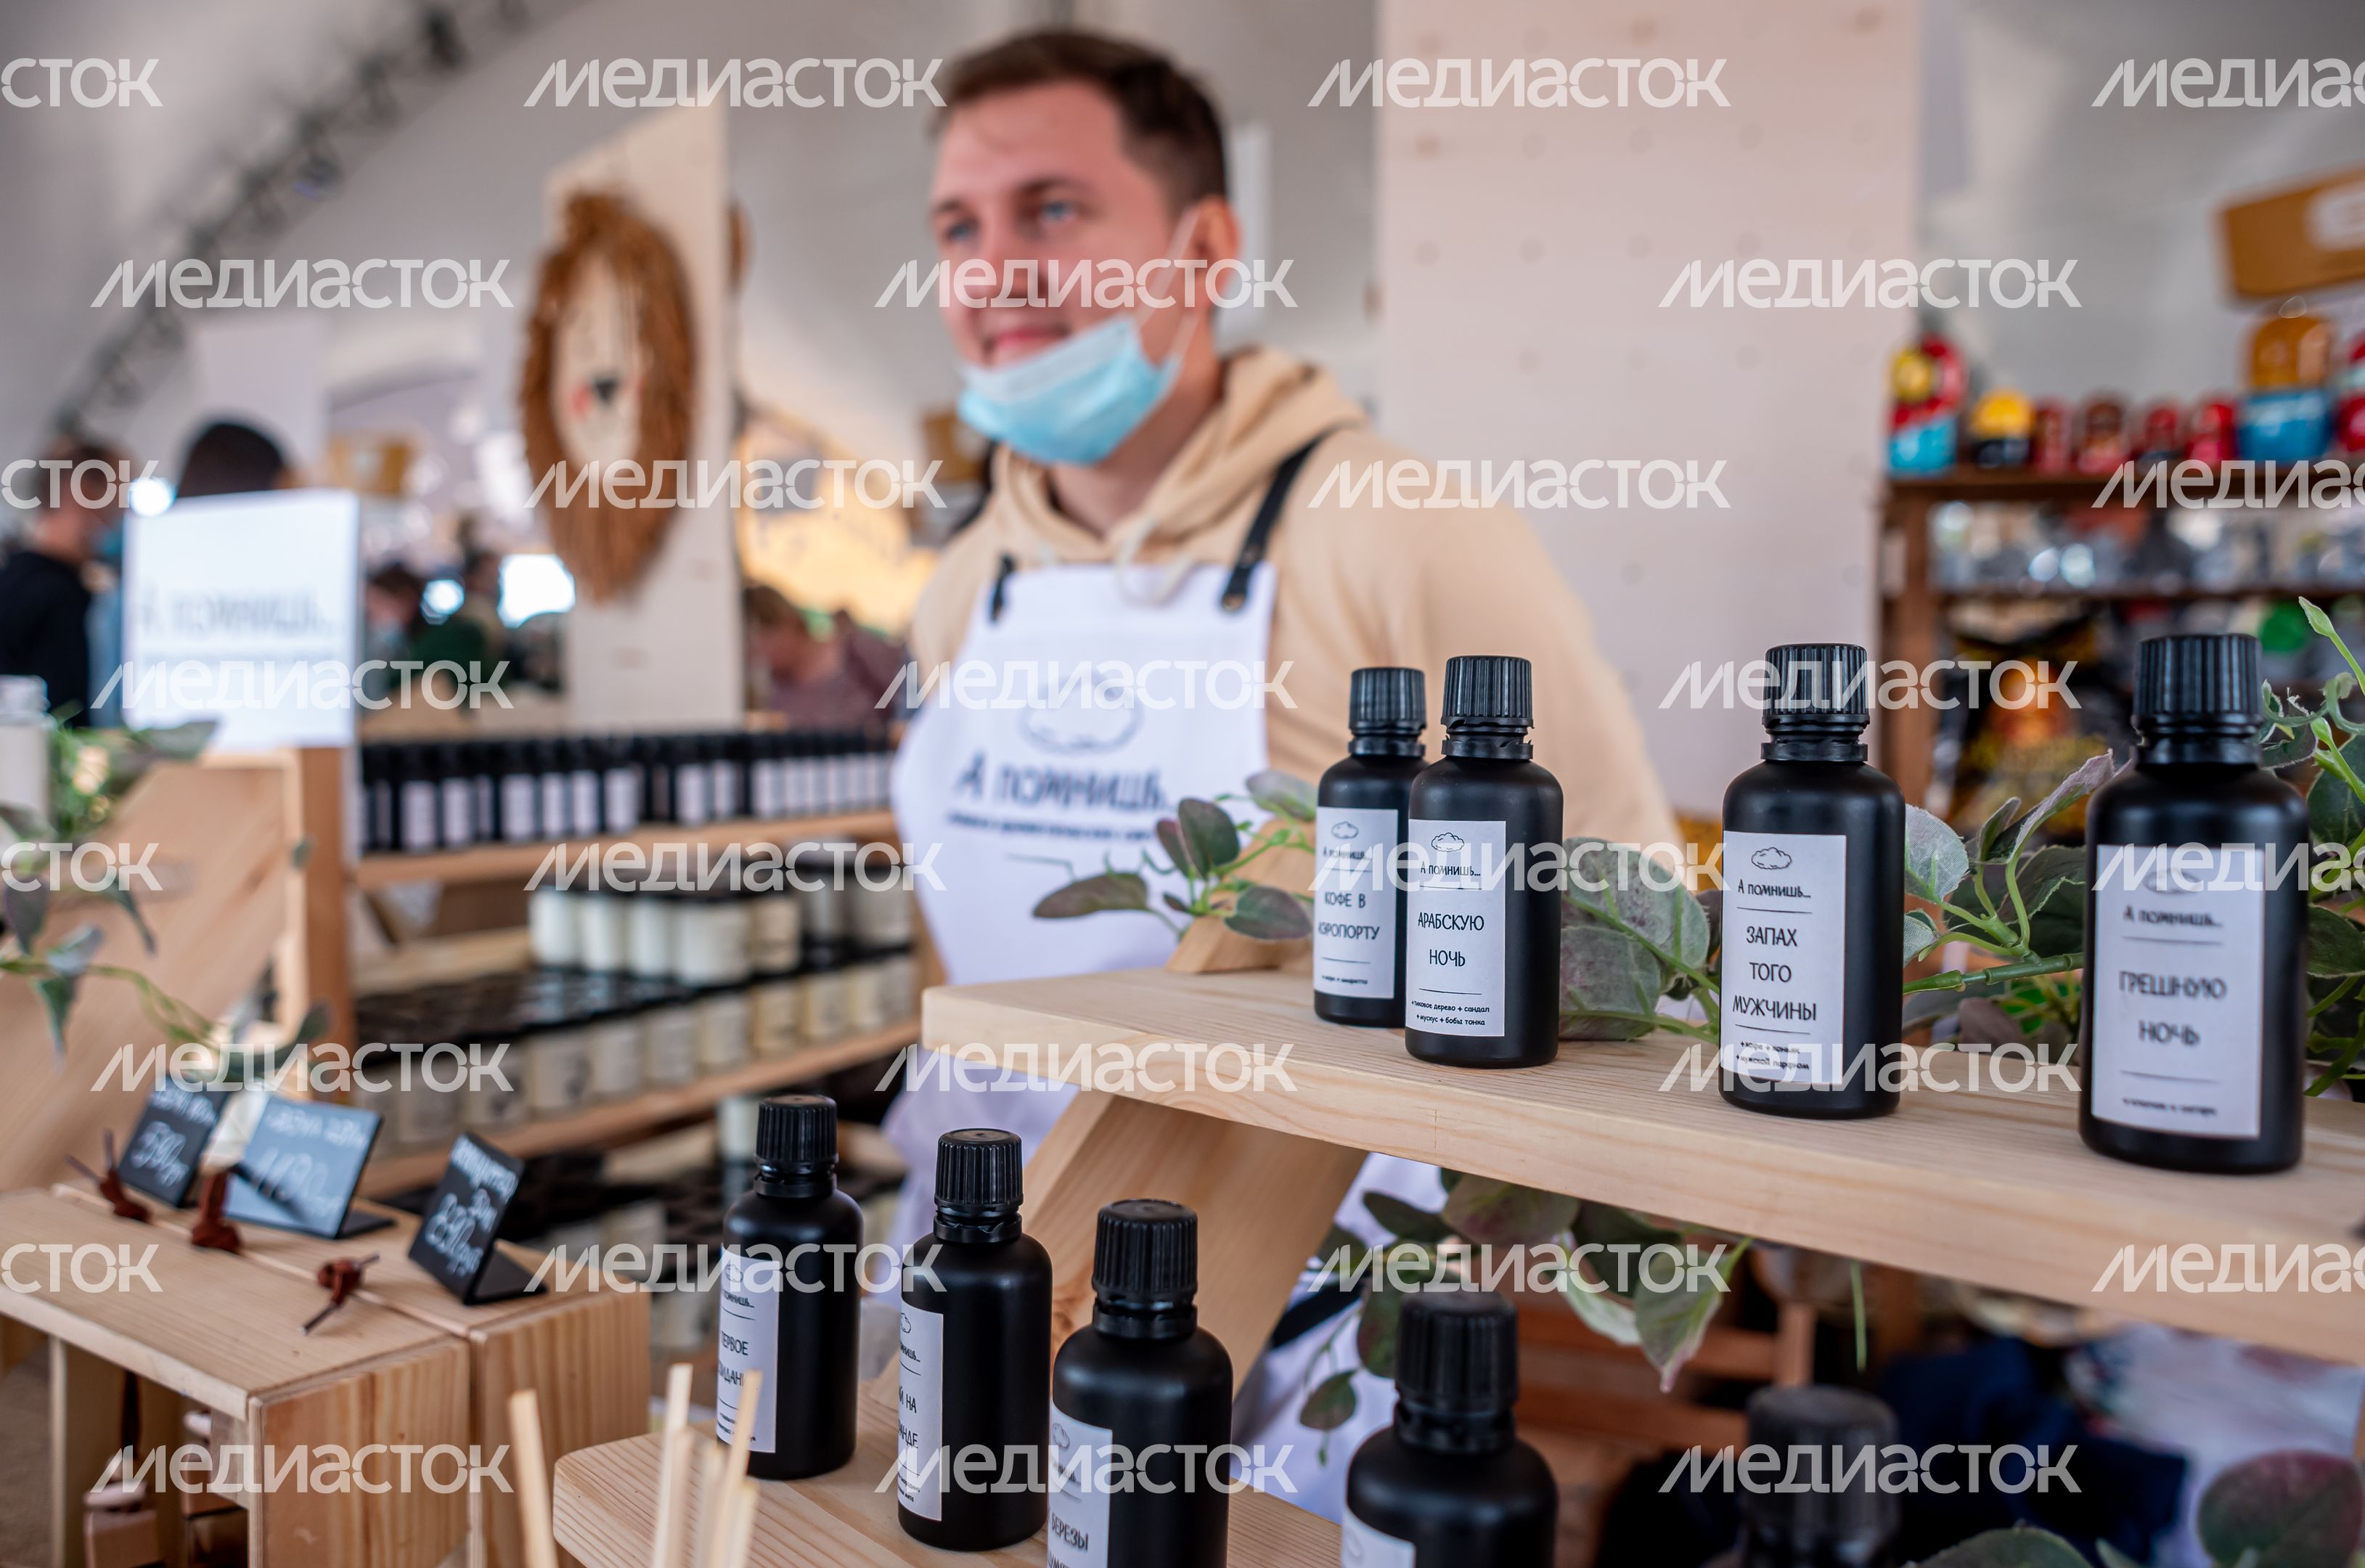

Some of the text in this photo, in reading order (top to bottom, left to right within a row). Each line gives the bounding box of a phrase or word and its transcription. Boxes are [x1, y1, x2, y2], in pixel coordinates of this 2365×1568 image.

[1421, 861, 1426, 874] А
[1738, 878, 1744, 894] А
[1325, 891, 1352, 907] КОФЕ
[1418, 912, 1484, 931] АРАБСКУЮ
[2123, 905, 2134, 923] А
[1746, 926, 1798, 947] ЗАПАХ
[1429, 949, 1466, 967] НОЧЬ
[1749, 962, 1792, 983] ТОГО
[2119, 970, 2227, 1000] ГРЕШНУЮ
[1434, 1003, 1456, 1012] дерево
[1733, 995, 1816, 1021] МУЖЧИНЫ
[1445, 1016, 1463, 1025] бобы
[2138, 1019, 2199, 1046] НОЧЬ
[905, 1393, 917, 1413] НА
[1052, 1511, 1088, 1551] БЕРЕЗЫ
